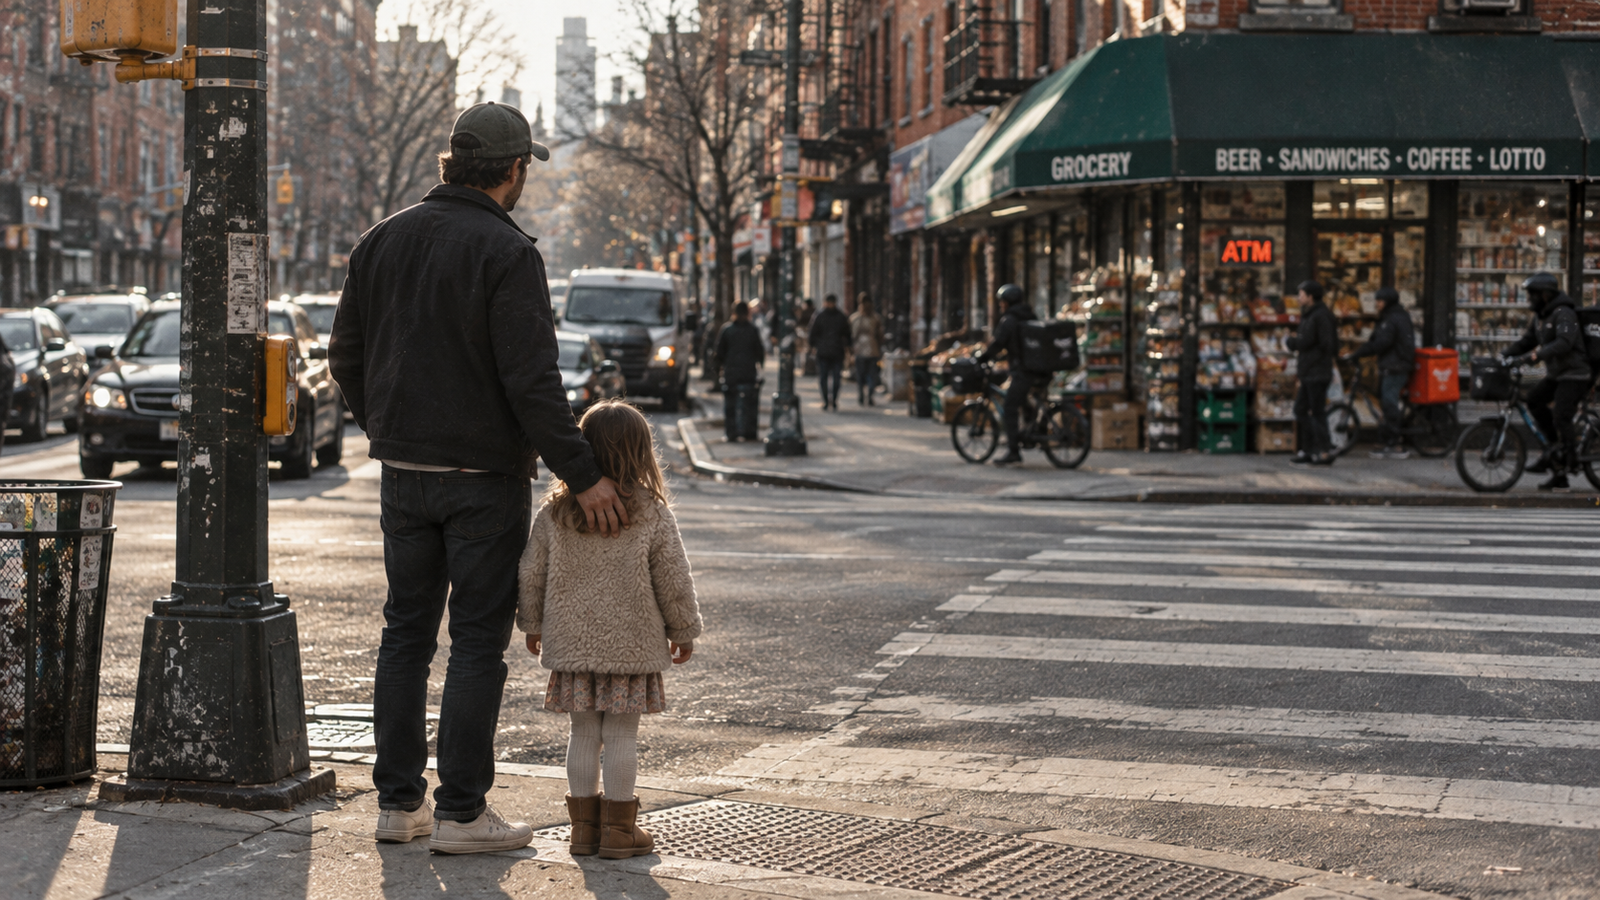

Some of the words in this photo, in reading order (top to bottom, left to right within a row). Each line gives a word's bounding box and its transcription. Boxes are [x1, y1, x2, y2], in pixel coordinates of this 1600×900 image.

[1051, 151, 1132, 181] GROCERY
[1215, 148, 1262, 172] BEER
[1279, 147, 1391, 172] SANDWICHES
[1406, 147, 1472, 172] COFFEE
[1489, 147, 1547, 172] LOTTO
[1221, 240, 1272, 264] ATM
